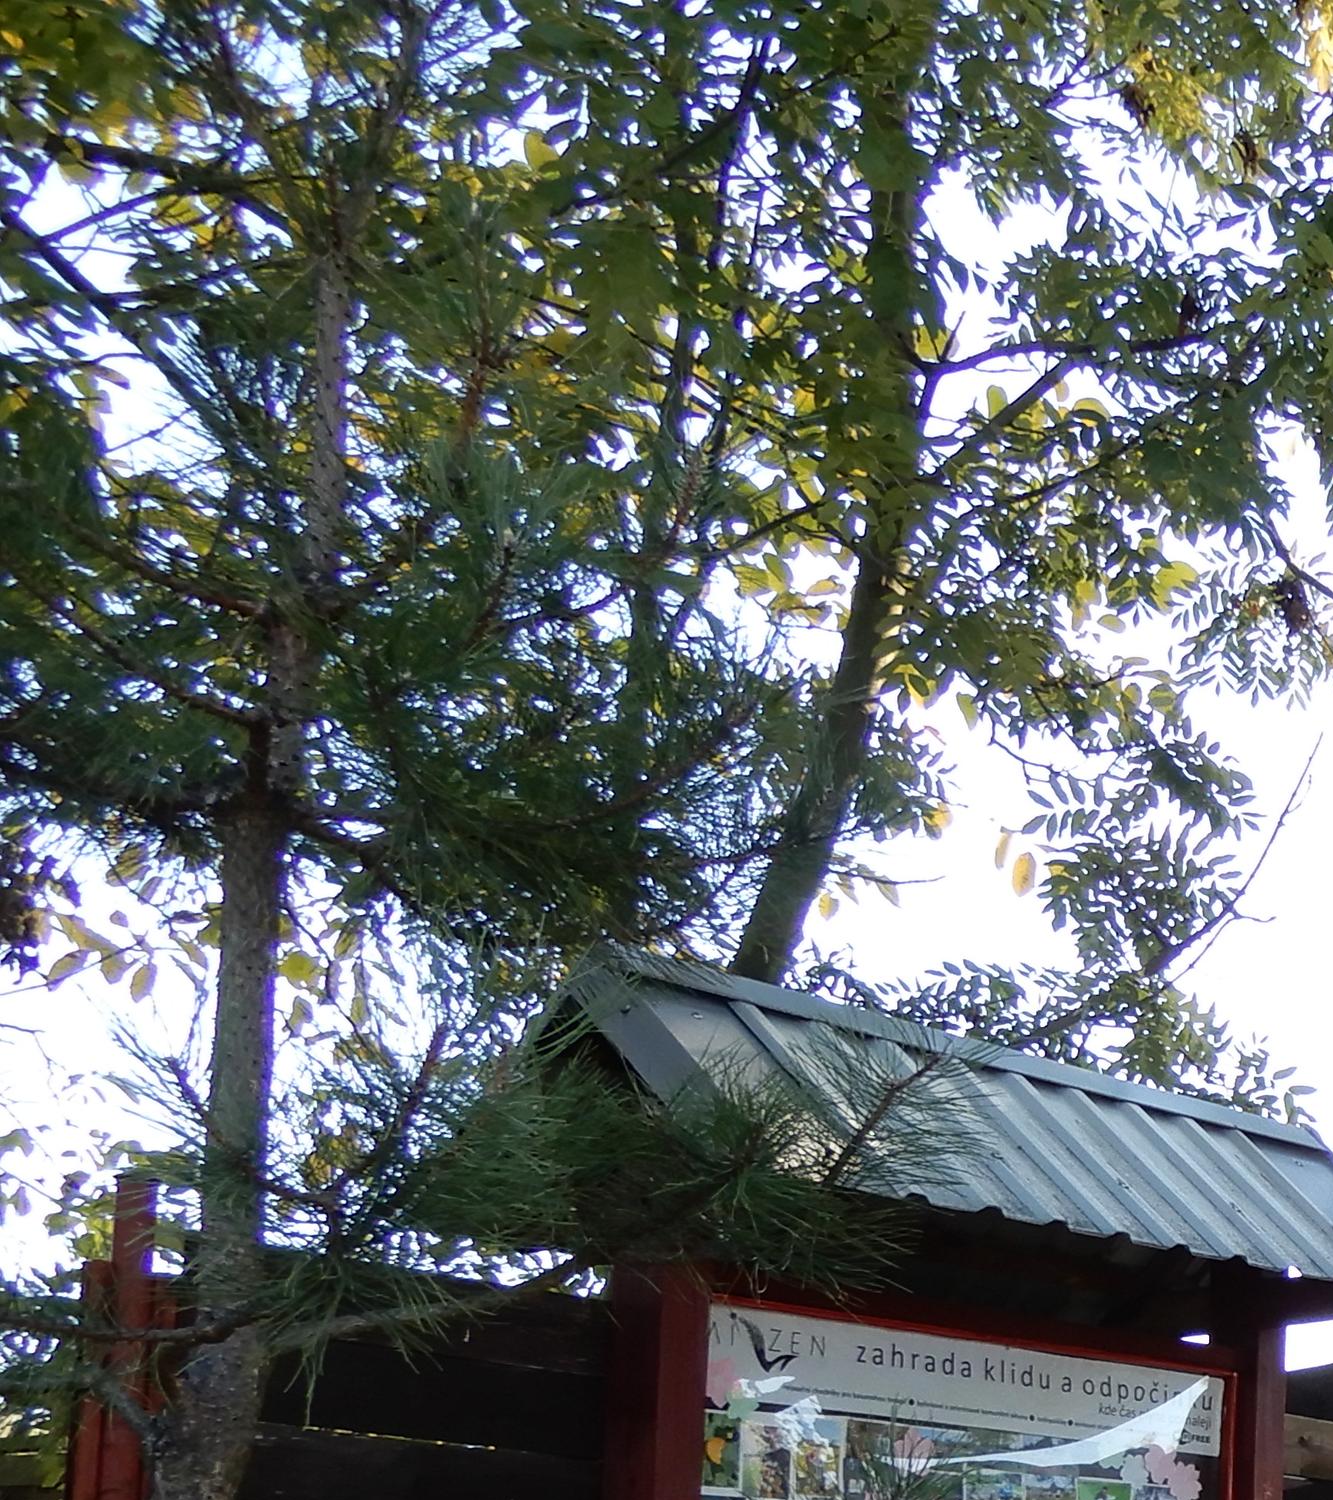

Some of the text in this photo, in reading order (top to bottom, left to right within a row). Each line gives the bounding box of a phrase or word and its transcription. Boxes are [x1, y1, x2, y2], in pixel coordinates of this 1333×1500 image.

[856, 1343, 972, 1377] zahrada
[984, 1358, 1050, 1390] klidu
[1061, 1376, 1072, 1393] a
